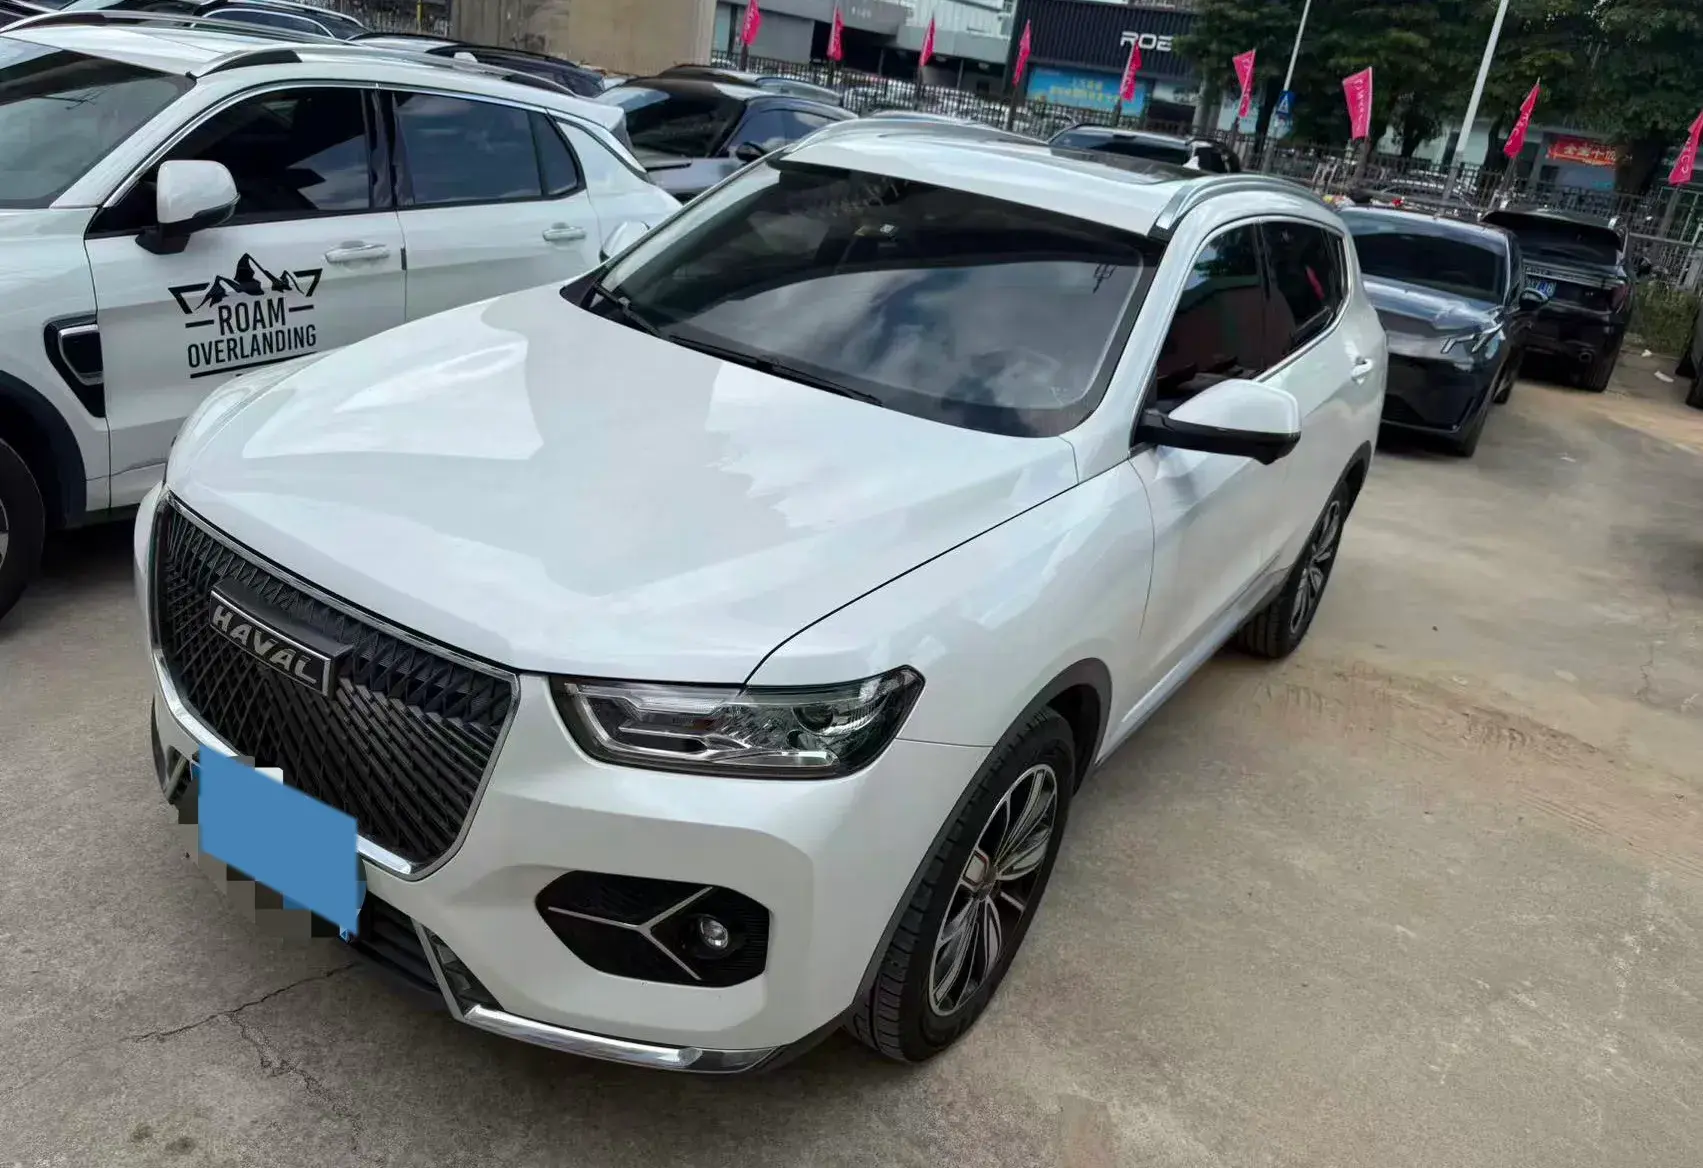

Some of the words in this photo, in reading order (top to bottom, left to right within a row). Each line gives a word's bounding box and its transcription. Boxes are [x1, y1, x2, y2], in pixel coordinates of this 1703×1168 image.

[218, 297, 286, 336] ROAM
[187, 324, 317, 368] OVERLANDING
[212, 605, 317, 684] HAVAL
